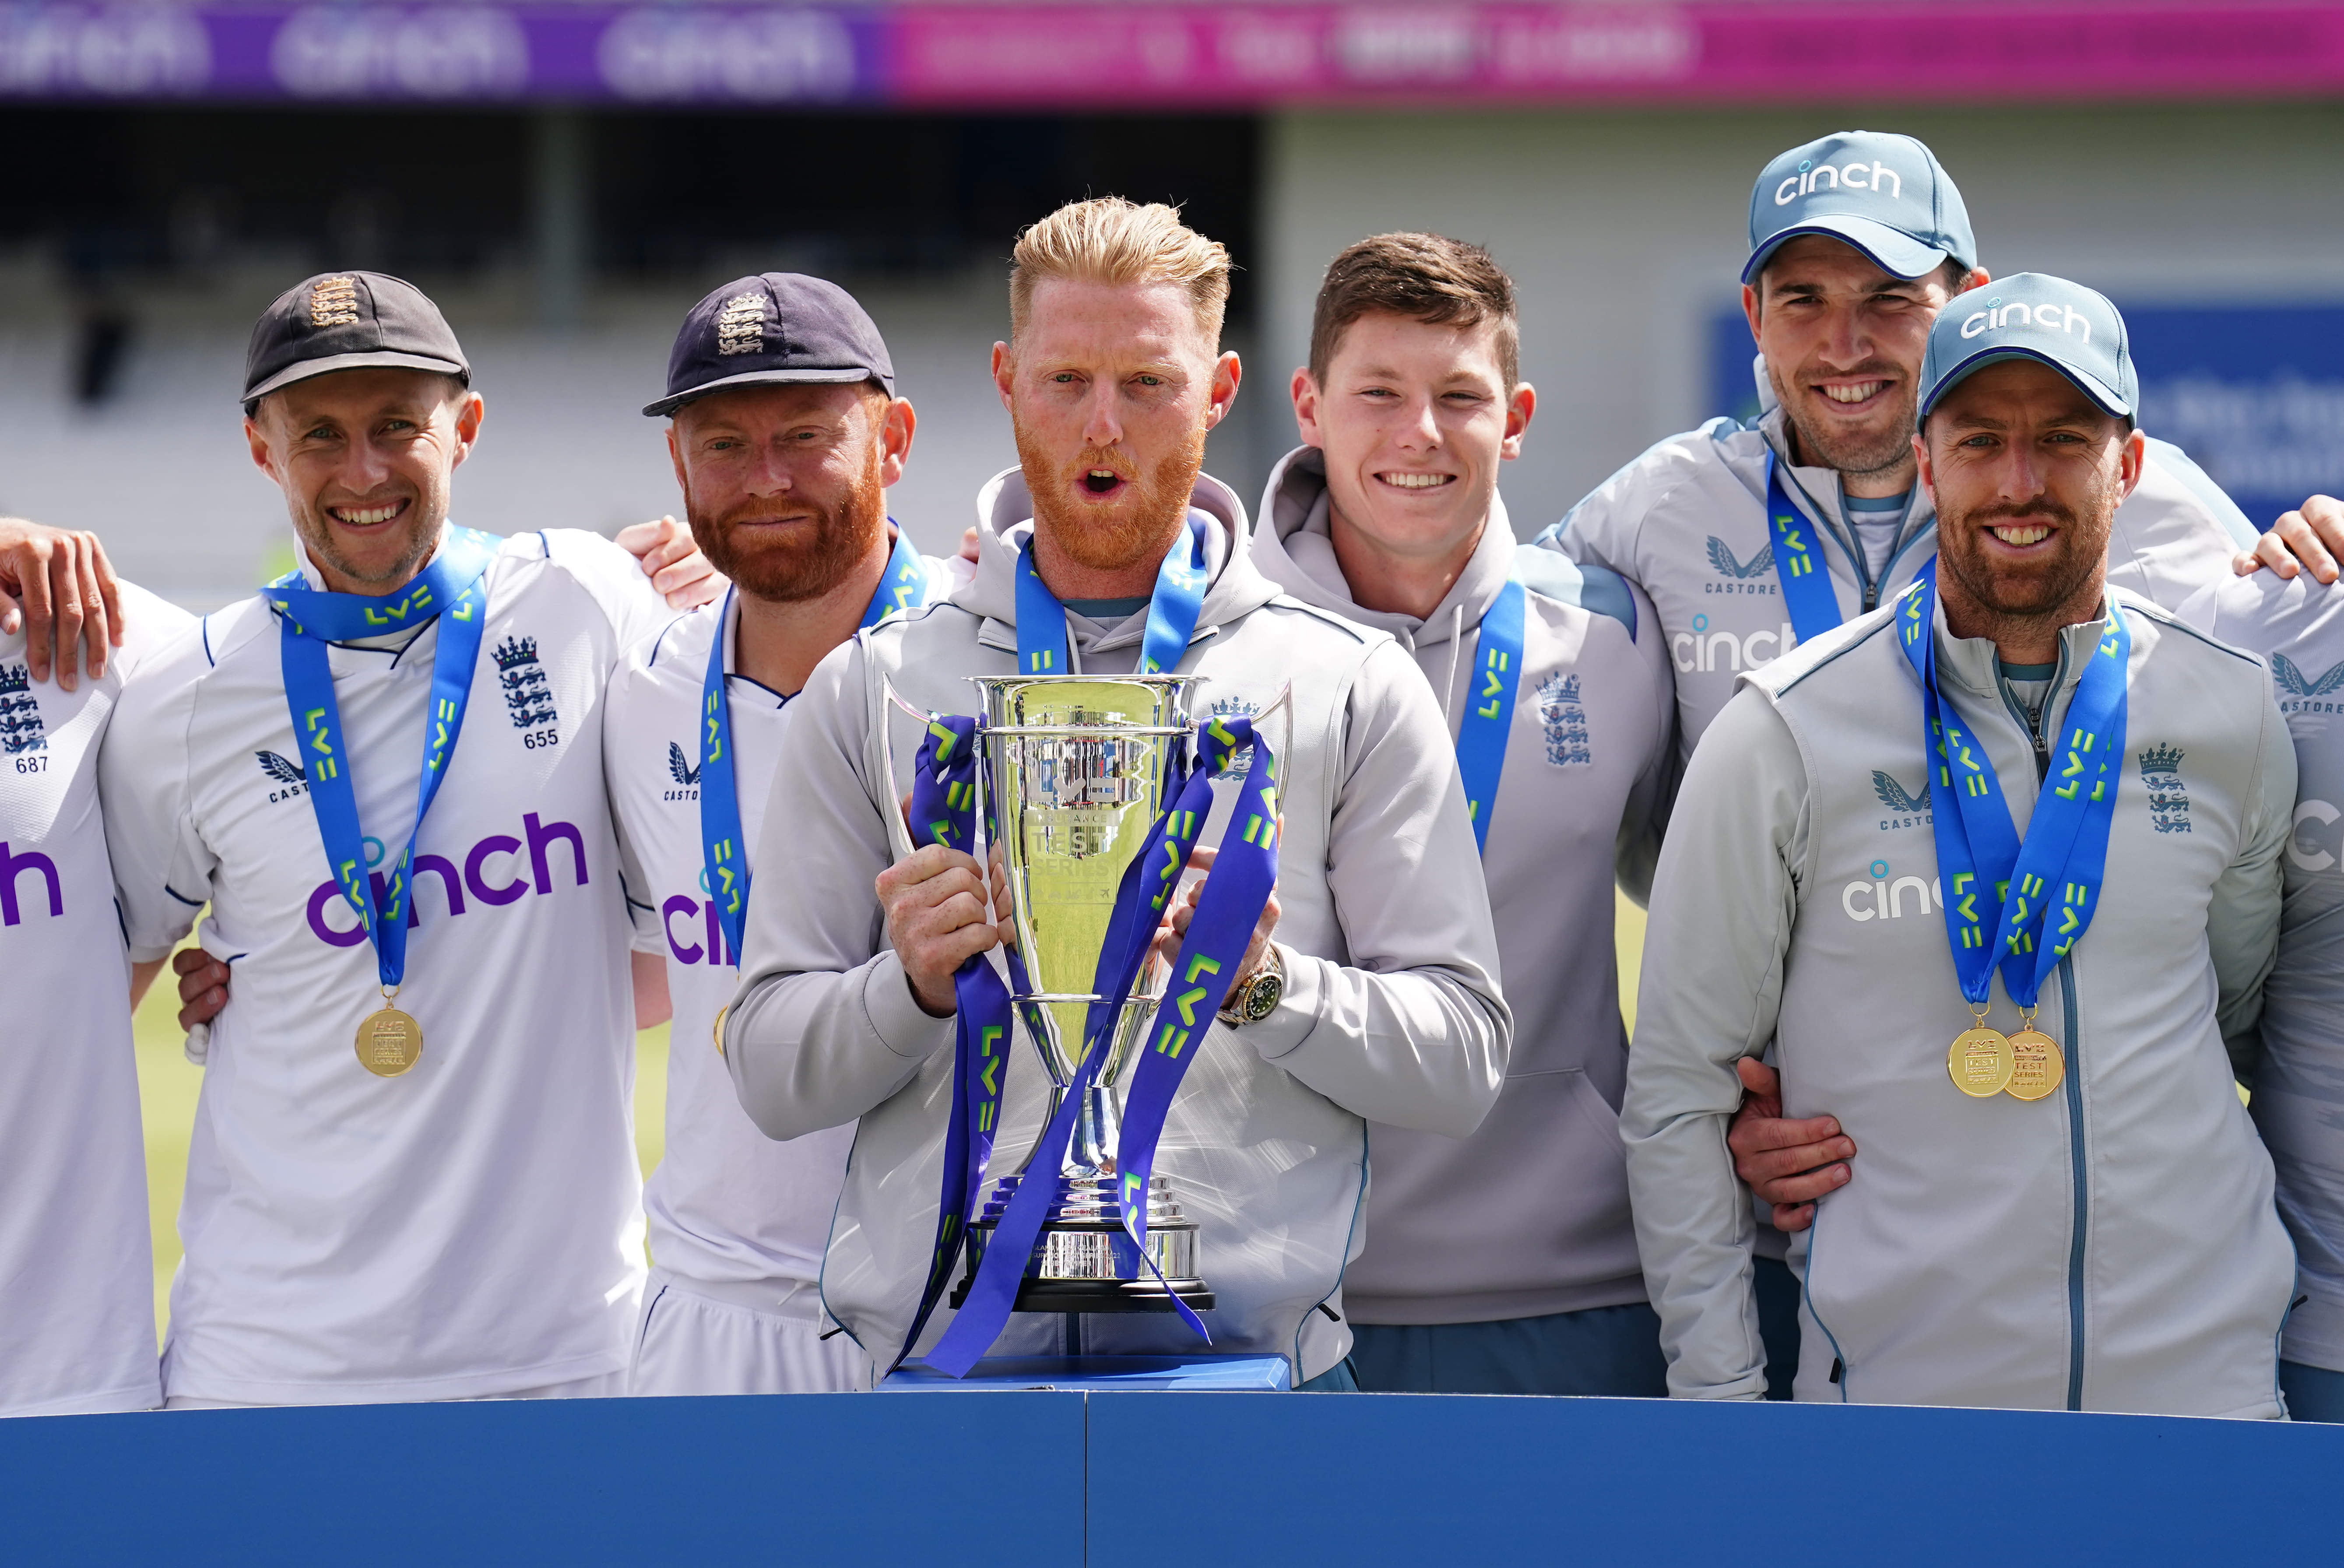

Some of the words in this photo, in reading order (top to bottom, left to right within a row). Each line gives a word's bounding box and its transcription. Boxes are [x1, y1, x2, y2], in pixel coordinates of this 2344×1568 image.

[1775, 160, 1900, 206] cinch
[1961, 297, 2091, 345] cinch
[1705, 583, 1776, 595] CASTORE
[524, 728, 558, 749] 655
[16, 756, 48, 773] 687
[1031, 832, 1108, 853] TEST
[1032, 858, 1109, 876] SERIES
